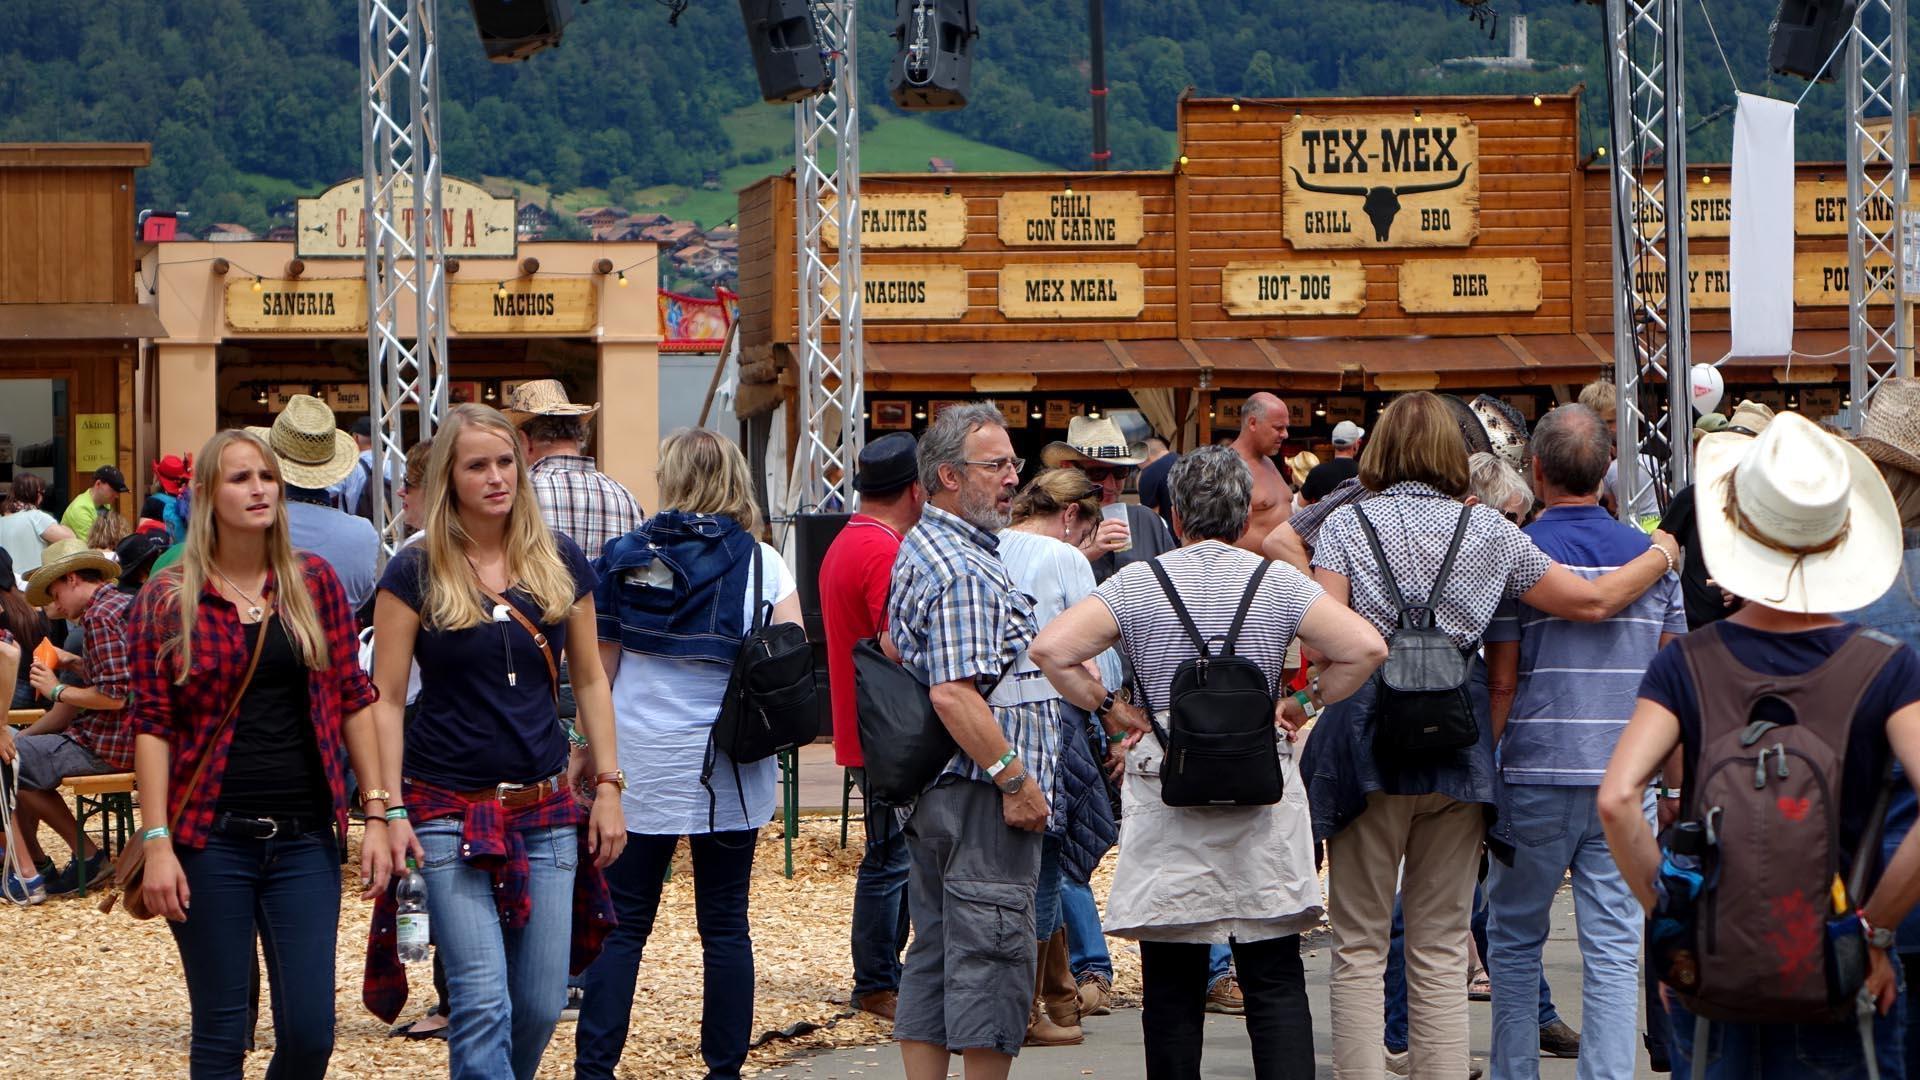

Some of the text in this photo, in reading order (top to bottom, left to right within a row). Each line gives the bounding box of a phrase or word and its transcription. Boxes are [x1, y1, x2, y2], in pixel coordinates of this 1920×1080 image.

[1302, 127, 1457, 174] TEX-MEX
[1050, 195, 1092, 218] CHILI
[861, 209, 927, 232] FAJITAS
[1026, 218, 1116, 241] CON CARNE
[1305, 210, 1351, 233] GRILL
[1421, 208, 1451, 231] BBQ
[864, 281, 926, 304] NACHOS
[1025, 279, 1117, 302] MEX MEAL
[1258, 275, 1331, 300] HOT-DOG
[1453, 273, 1489, 297] BIER
[263, 292, 336, 316] SANGRIA
[493, 293, 555, 316] NACHOS
